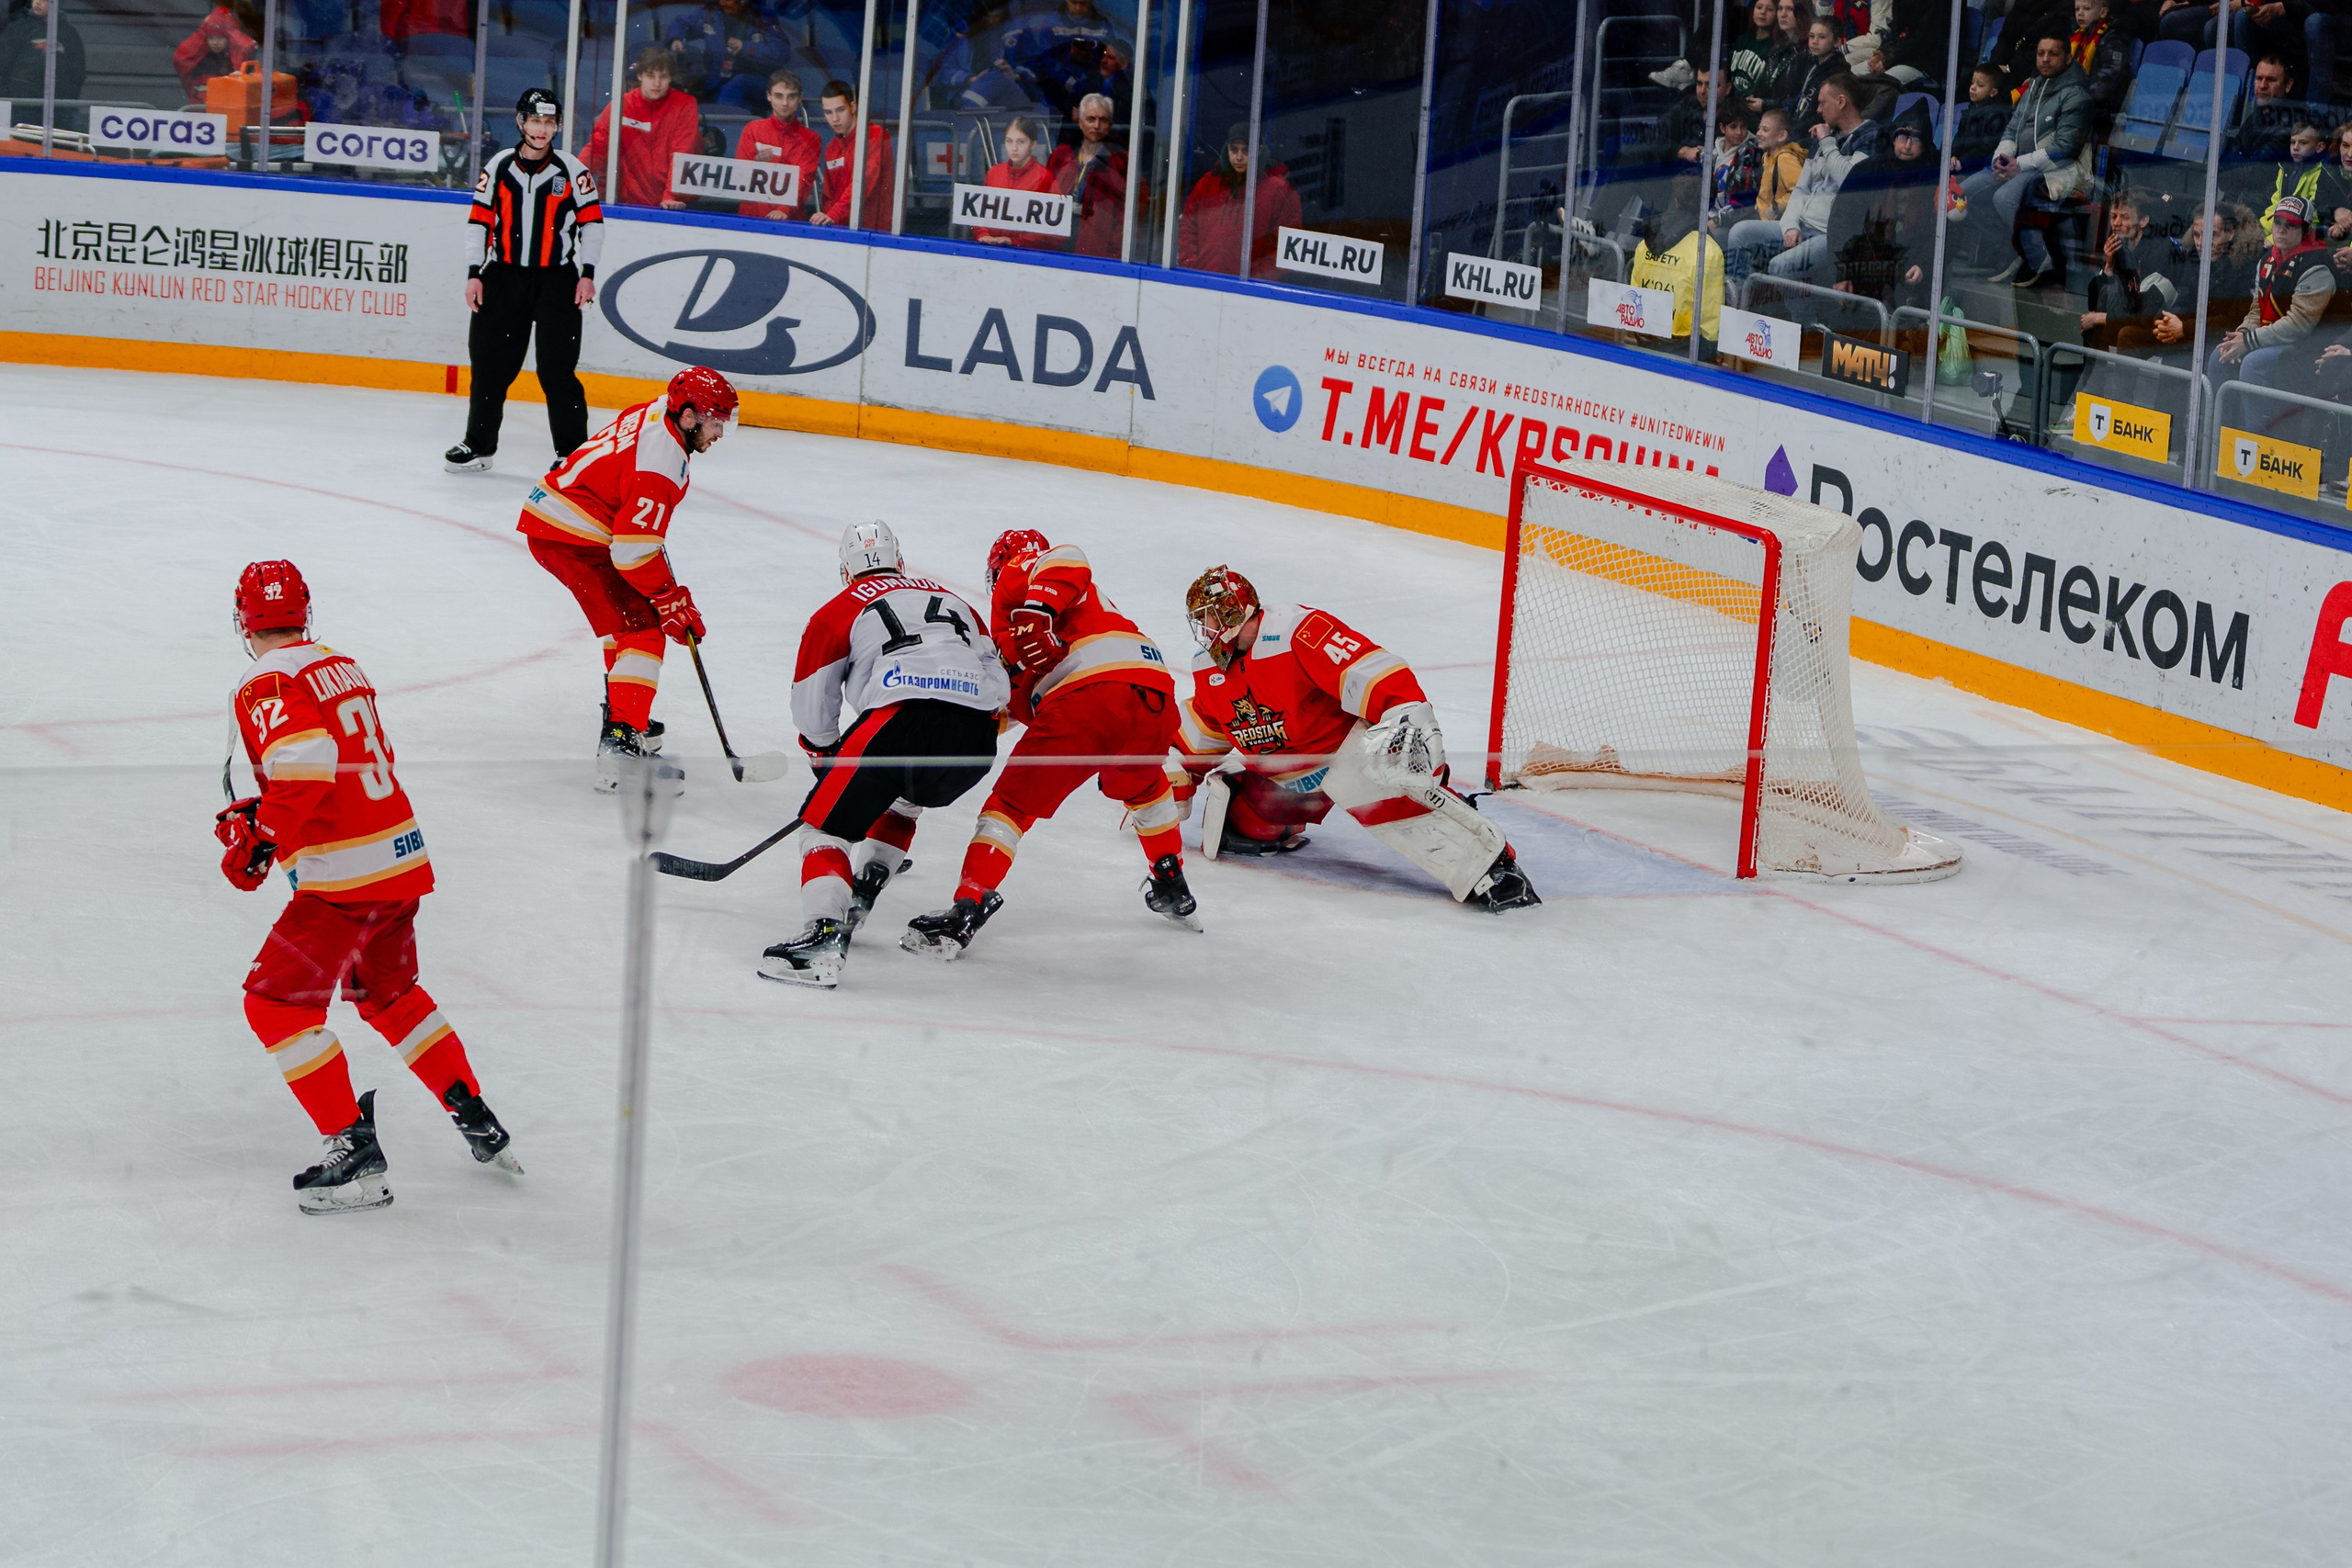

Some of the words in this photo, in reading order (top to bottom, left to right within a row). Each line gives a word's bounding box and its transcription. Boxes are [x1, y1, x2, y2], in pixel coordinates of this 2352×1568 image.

[679, 161, 793, 197] KHL.RU
[960, 191, 1066, 227] KHL.RU
[36, 218, 408, 283] 北京昆仑鸿星冰球俱乐部
[1283, 235, 1376, 274] KHL.RU
[35, 266, 106, 294] BEIJING
[113, 272, 185, 299] KUNLUN
[192, 277, 226, 303] RED
[233, 280, 277, 306] STAR
[285, 285, 356, 312] HOCKEY
[362, 290, 407, 317] CLUB
[1452, 262, 1536, 300] KHL.RU
[1615, 302, 1635, 316] АВТО
[1620, 314, 1645, 329] РАДИО
[904, 297, 1157, 401] LADA
[1746, 332, 1764, 346] АВТО
[1749, 344, 1773, 360] РАДИО
[1831, 339, 1897, 389] МАТЧ!
[1324, 347, 1350, 366] МЫ
[1357, 353, 1415, 378] ВСЕГДА
[1423, 366, 1442, 384] НА
[1449, 371, 1498, 395] СВЯЗИ
[1503, 382, 1625, 424] #REDSTARHOCKEY
[1630, 412, 1725, 452] #UNITEDWEWIN
[2113, 420, 2154, 444] БАНК
[2259, 453, 2304, 479] БАНК
[631, 496, 665, 531] 21
[864, 551, 881, 568] 14
[264, 582, 284, 601] 32
[862, 594, 972, 656] 14
[1322, 631, 1362, 666] 45
[901, 674, 979, 696] ГАЗПРОМНЕФТЬ
[940, 668, 962, 678] СЕТЬ
[964, 671, 979, 682] АЗС
[251, 698, 289, 745] 32
[1231, 719, 1289, 749] REDSTAR
